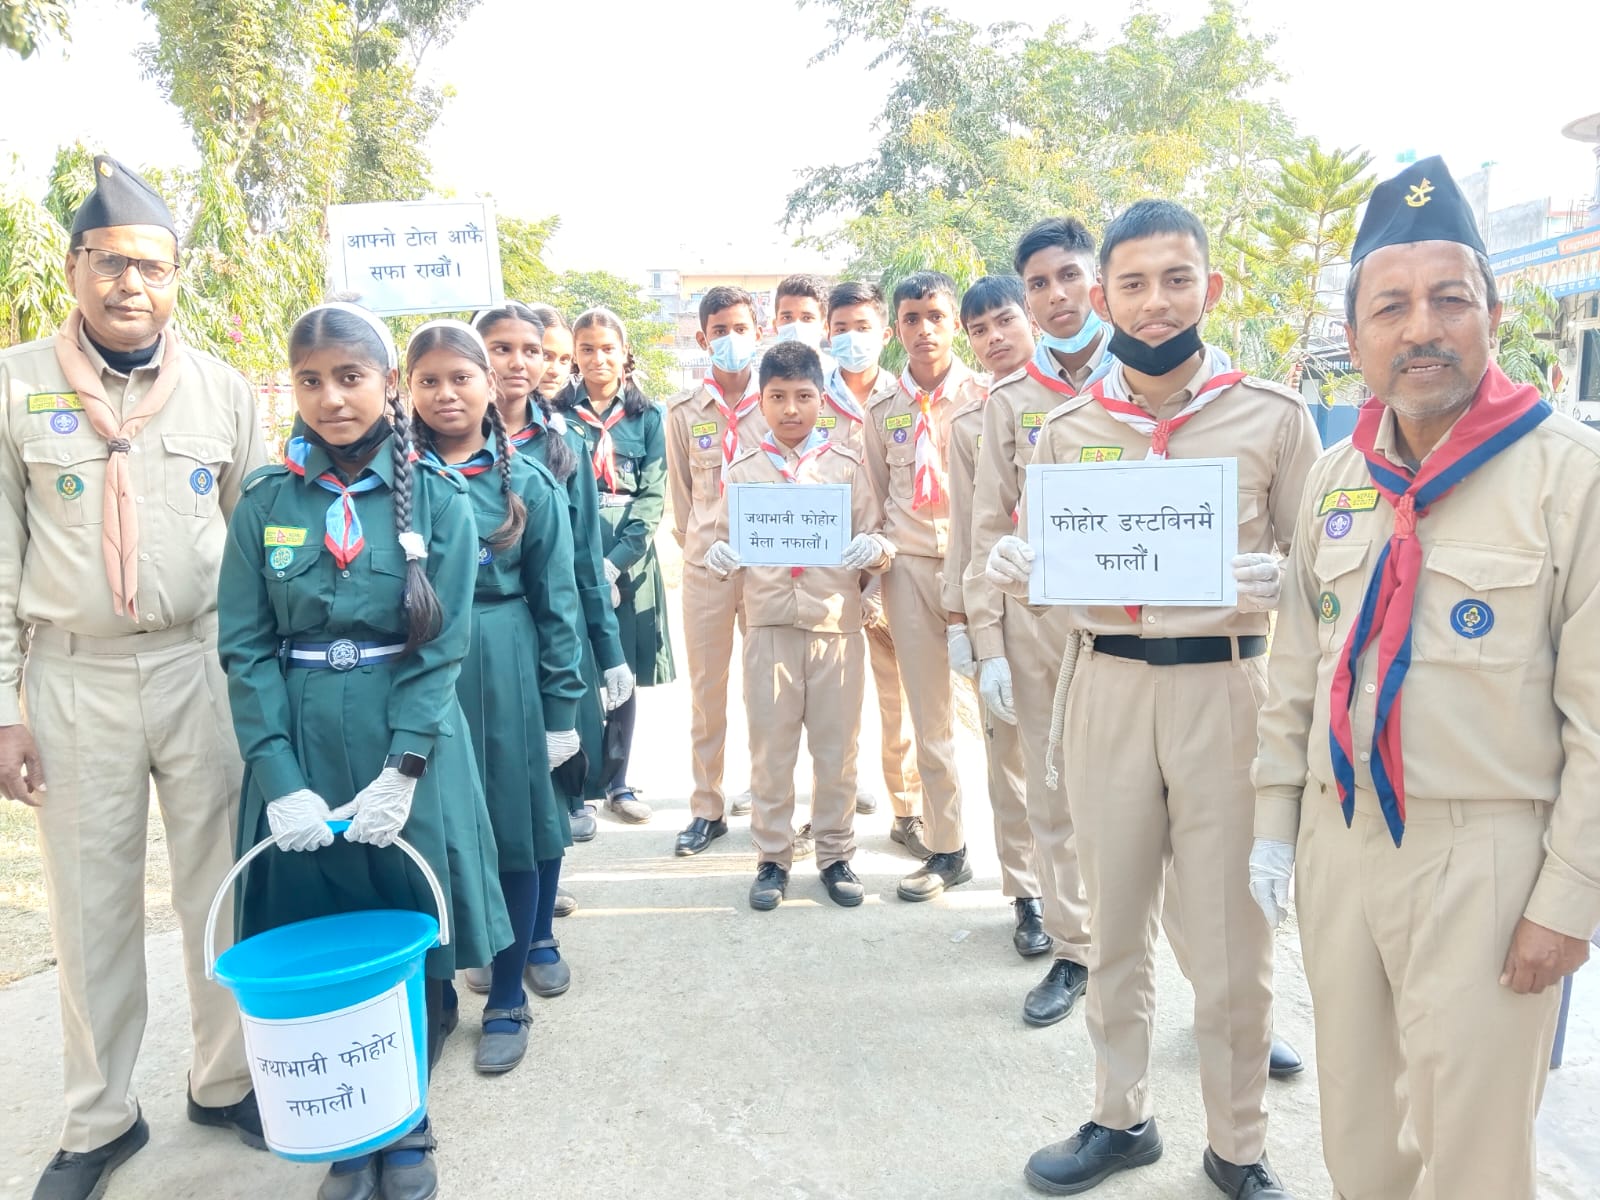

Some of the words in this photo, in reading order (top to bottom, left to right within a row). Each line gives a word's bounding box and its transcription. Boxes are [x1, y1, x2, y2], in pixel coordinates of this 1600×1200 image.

[404, 226, 438, 247] टोल
[369, 265, 407, 281] सफा
[800, 509, 839, 527] फोहोर
[1049, 507, 1109, 534] फोहोर
[1117, 501, 1215, 532] डस्टबिनमै
[748, 530, 775, 549] मैला
[1094, 543, 1159, 572] फालौं।
[337, 1031, 398, 1068] फोहोर
[285, 1082, 367, 1118] नफालौं।
